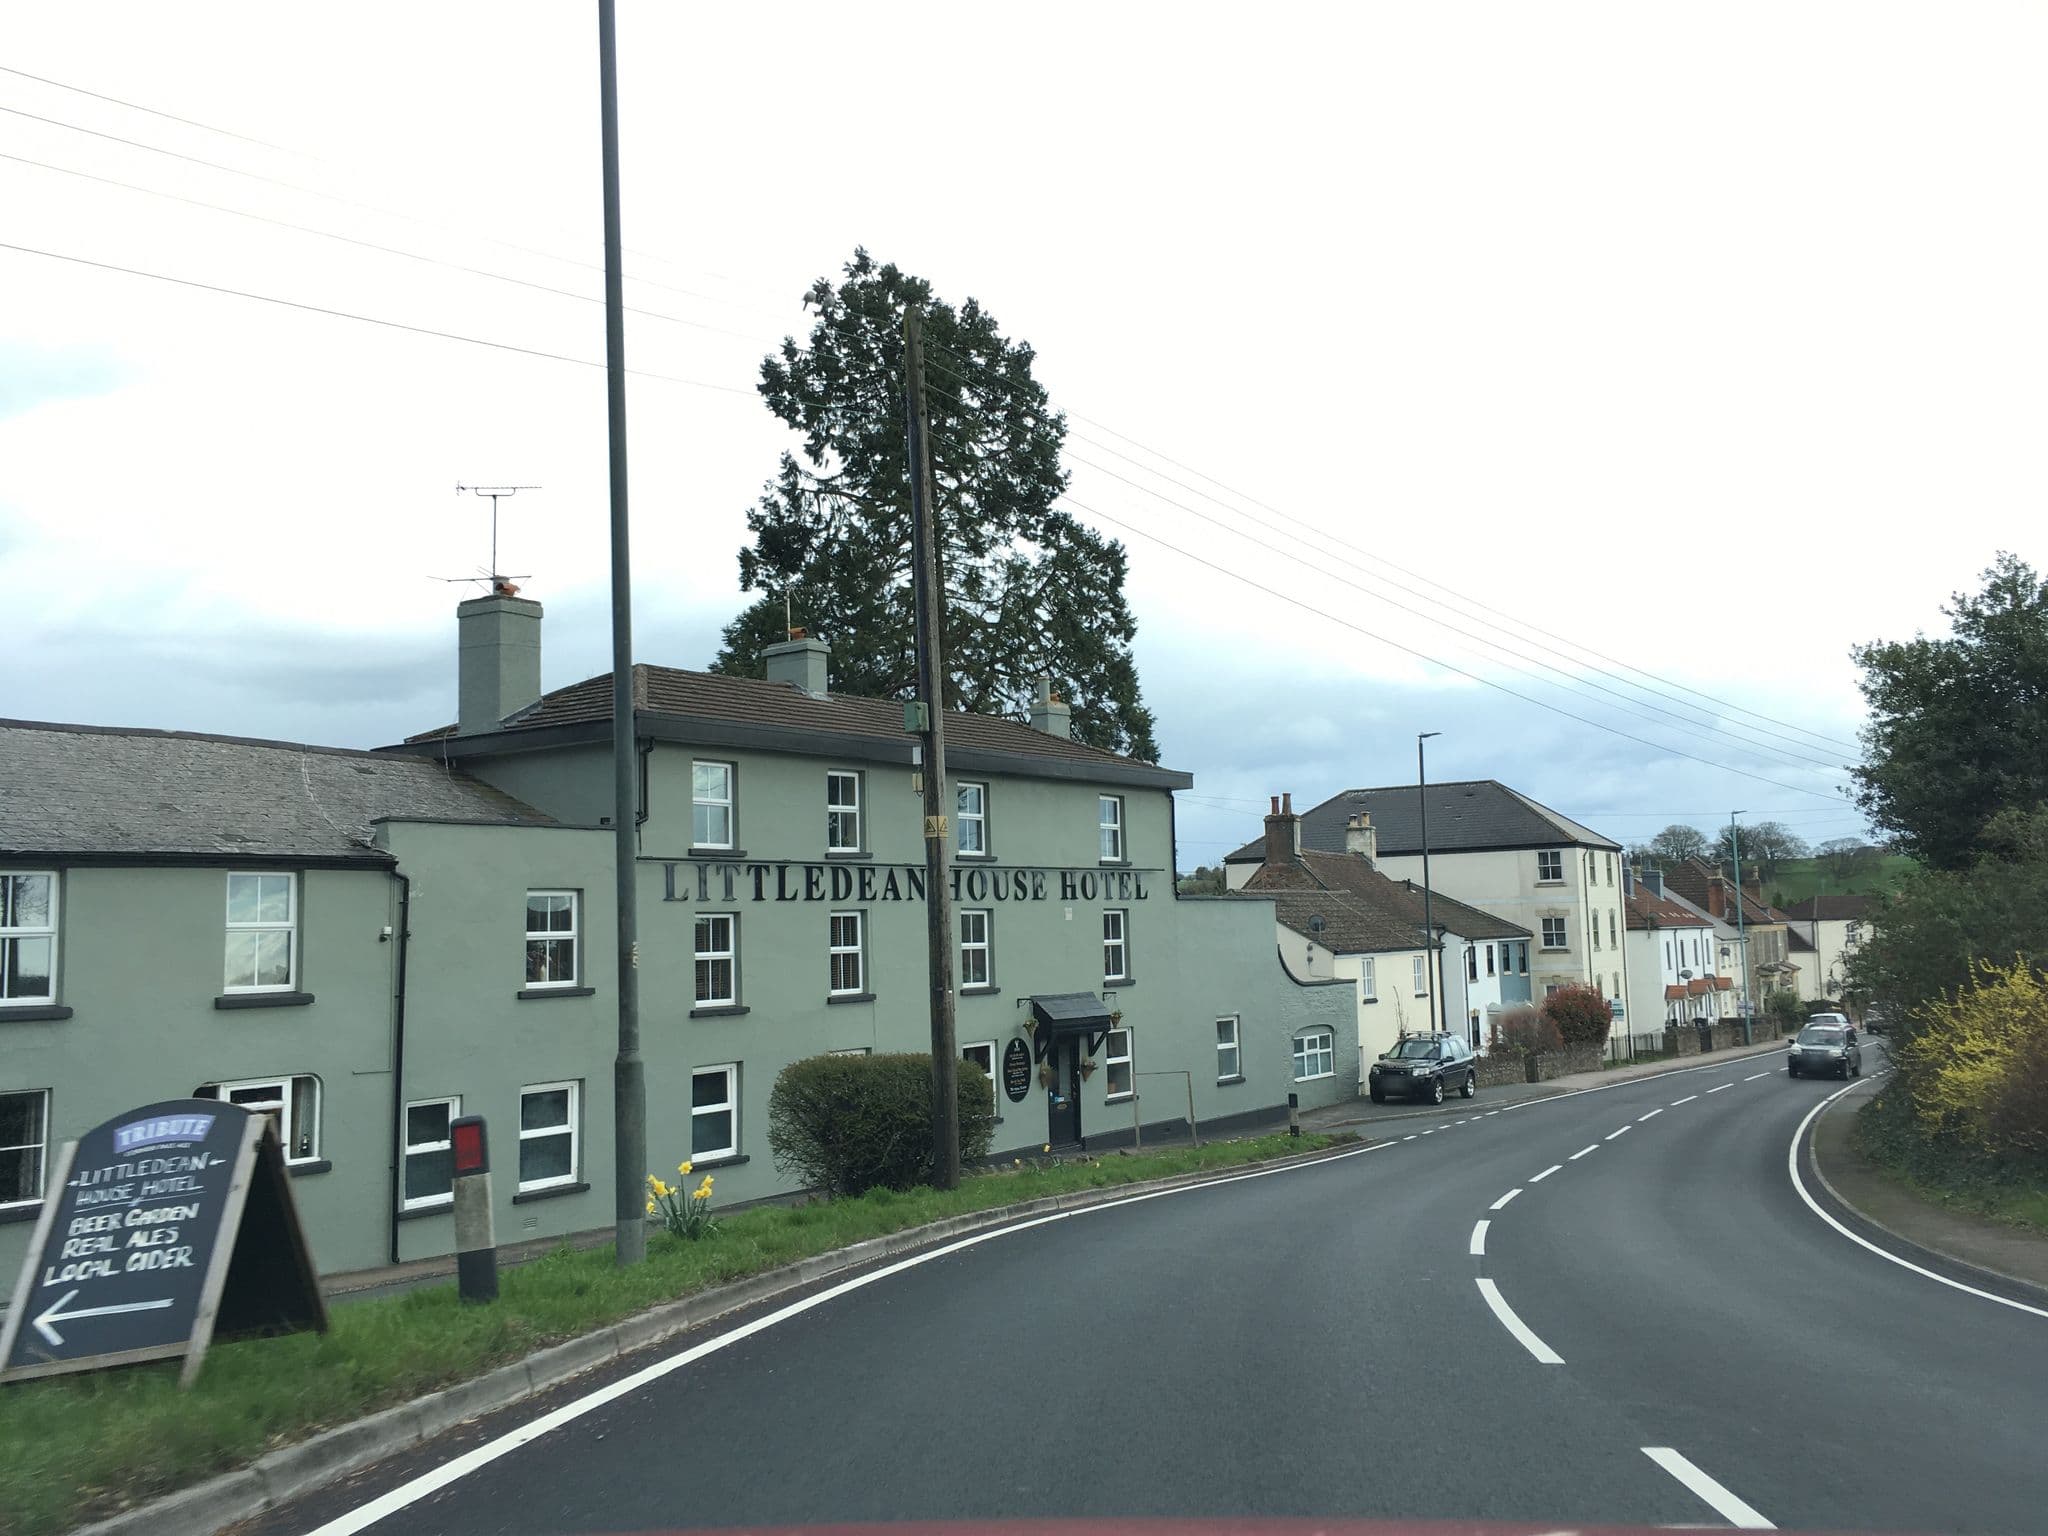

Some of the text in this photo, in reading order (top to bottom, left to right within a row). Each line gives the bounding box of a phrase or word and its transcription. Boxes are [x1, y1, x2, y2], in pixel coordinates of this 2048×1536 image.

[662, 863, 1149, 901] LITTLEDEAN HOUSE HOTEL
[118, 1119, 210, 1146] TRIBUTE
[140, 1175, 204, 1196] HOTEL
[68, 1212, 122, 1237] BEER
[60, 1226, 179, 1260] REAL ALES
[42, 1245, 196, 1287] LOCAL CIDER
